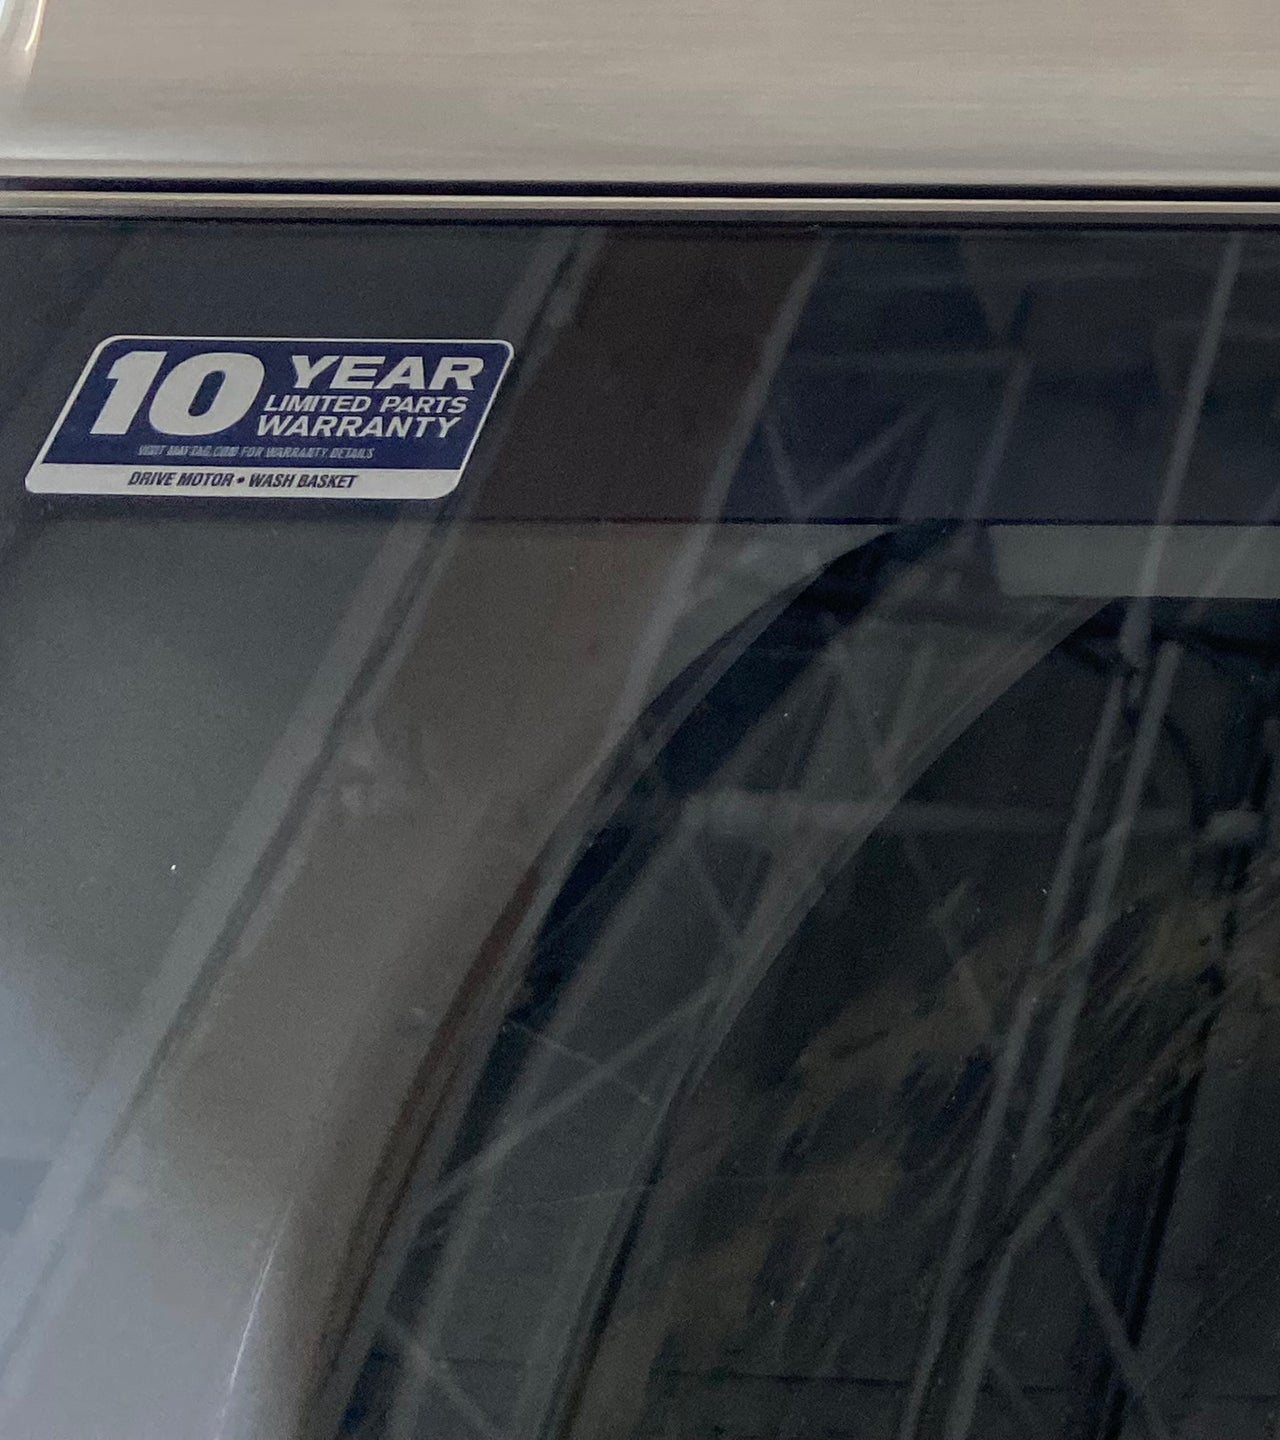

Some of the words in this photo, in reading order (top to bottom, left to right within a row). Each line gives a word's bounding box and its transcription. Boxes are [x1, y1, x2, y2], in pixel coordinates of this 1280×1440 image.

[291, 355, 484, 392] YEAR
[89, 350, 266, 436] 10
[263, 394, 371, 413] LIMITED
[379, 395, 469, 415] PARTS
[256, 415, 463, 439] WARRANTY
[241, 446, 264, 458] FOR
[266, 447, 329, 460] WARRANTY
[127, 471, 179, 487] DRIVE
[177, 472, 235, 488] MOTOR
[248, 473, 300, 489] WASH
[298, 474, 360, 490] BASKET
